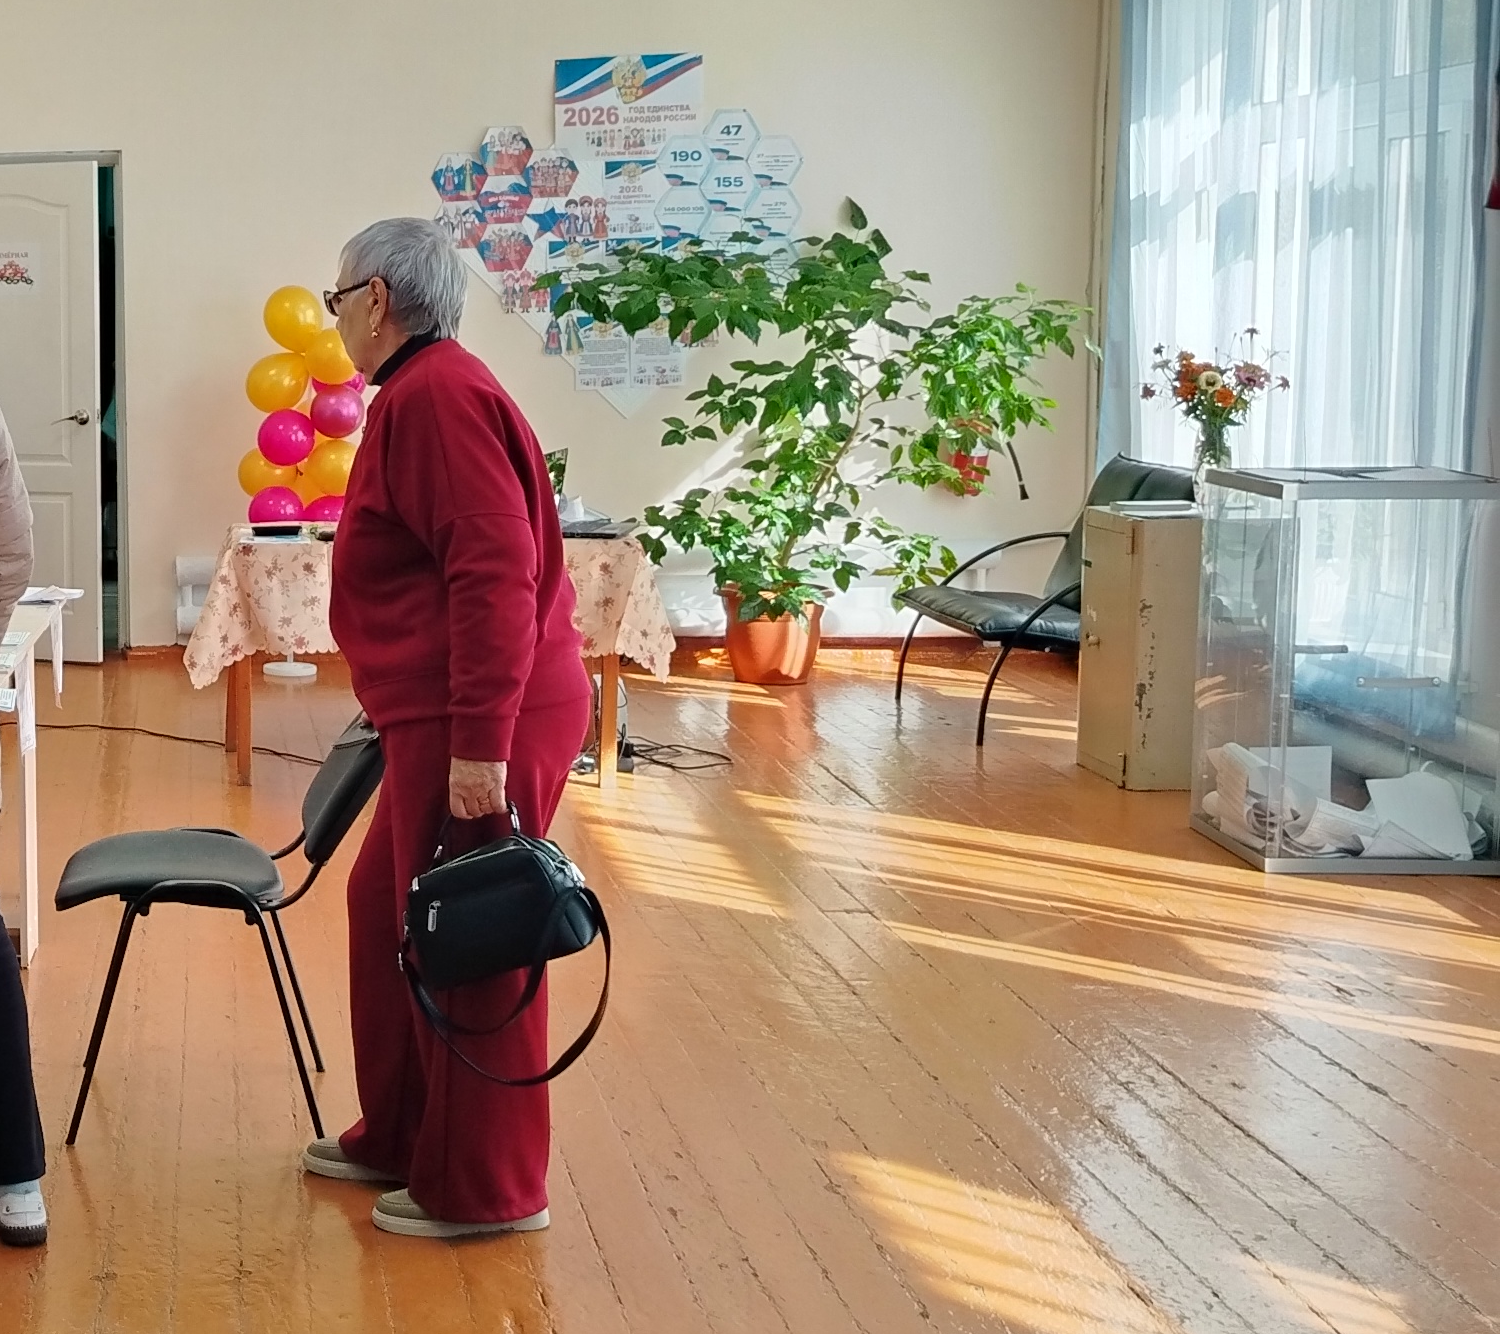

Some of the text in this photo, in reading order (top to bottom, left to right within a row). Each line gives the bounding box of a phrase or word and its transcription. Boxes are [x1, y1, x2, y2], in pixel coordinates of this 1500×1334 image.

[628, 104, 691, 115] ГОД ЕДИНСТВА
[563, 105, 619, 127] 2026
[623, 113, 697, 124] НАРОДОВ РОССИИ
[720, 125, 742, 136] 47
[670, 150, 702, 162] 190
[714, 176, 743, 187] 155
[619, 185, 643, 193] 2026
